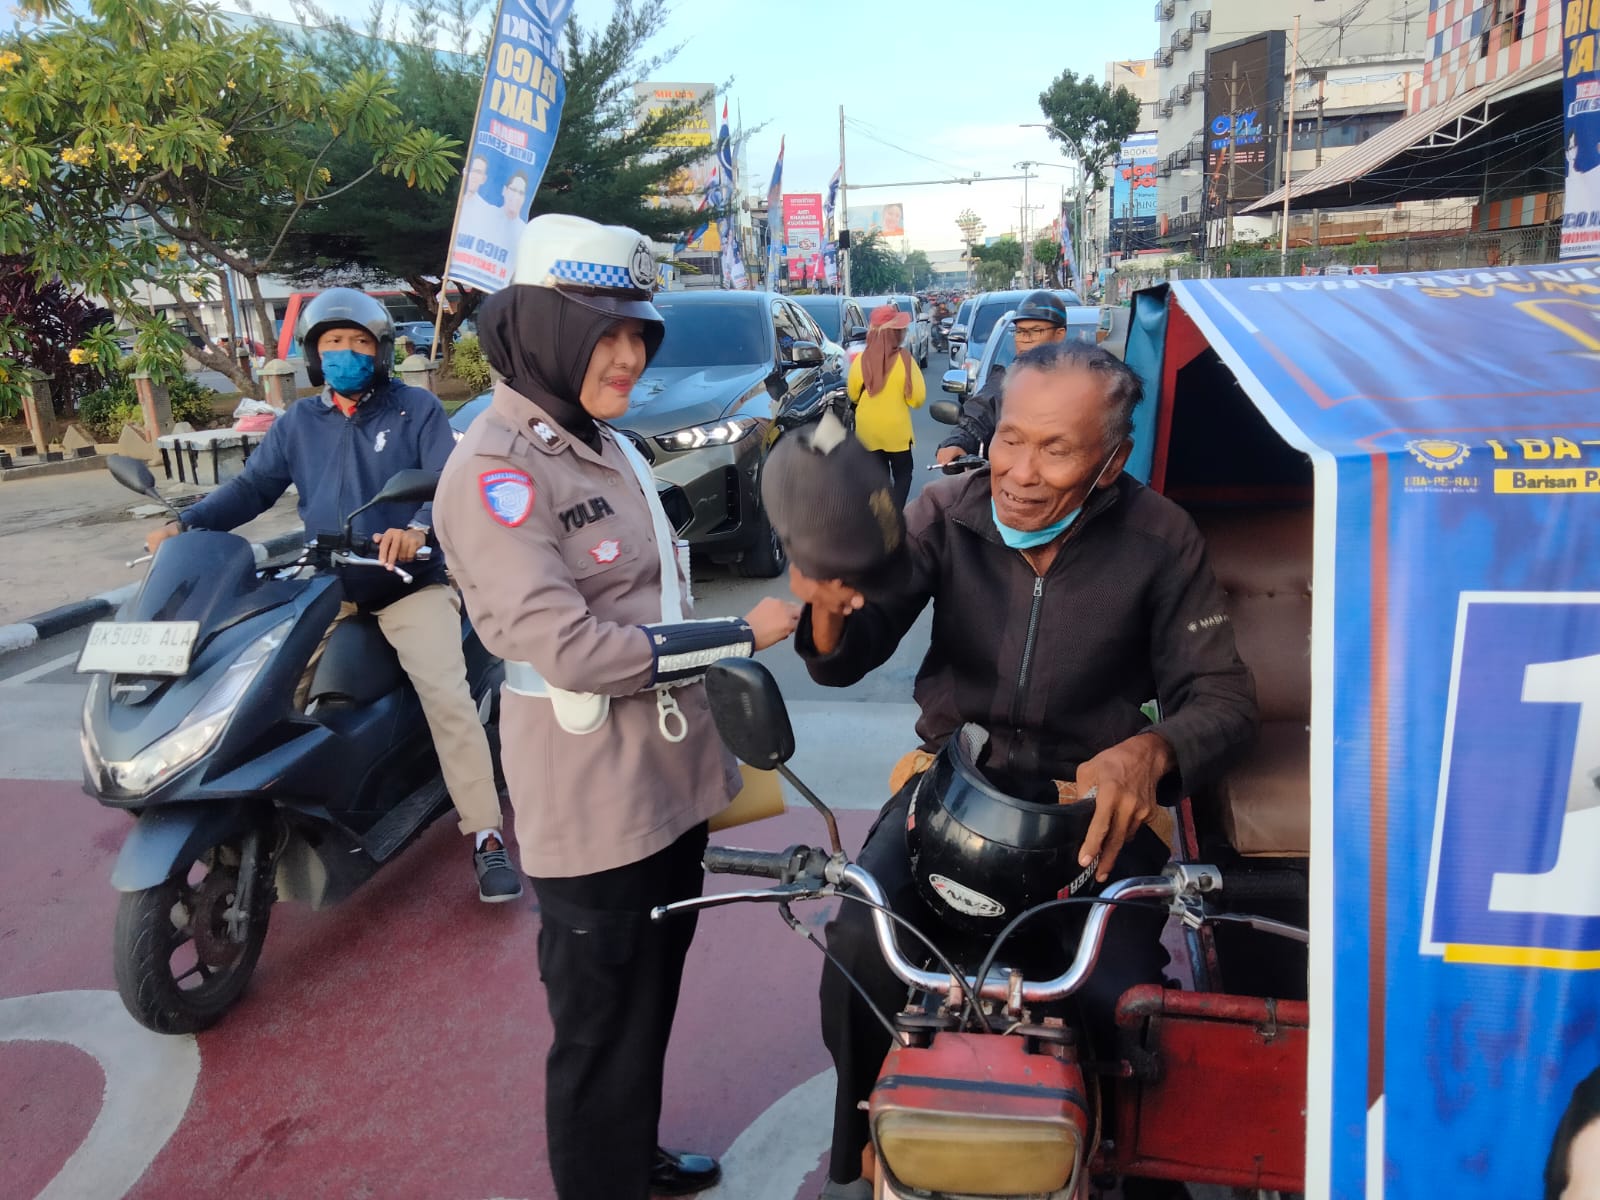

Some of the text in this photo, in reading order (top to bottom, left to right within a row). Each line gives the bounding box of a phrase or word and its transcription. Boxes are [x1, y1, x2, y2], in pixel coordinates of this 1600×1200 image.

[1513, 470, 1600, 489] Barisan P
[160, 627, 193, 646] ALA
